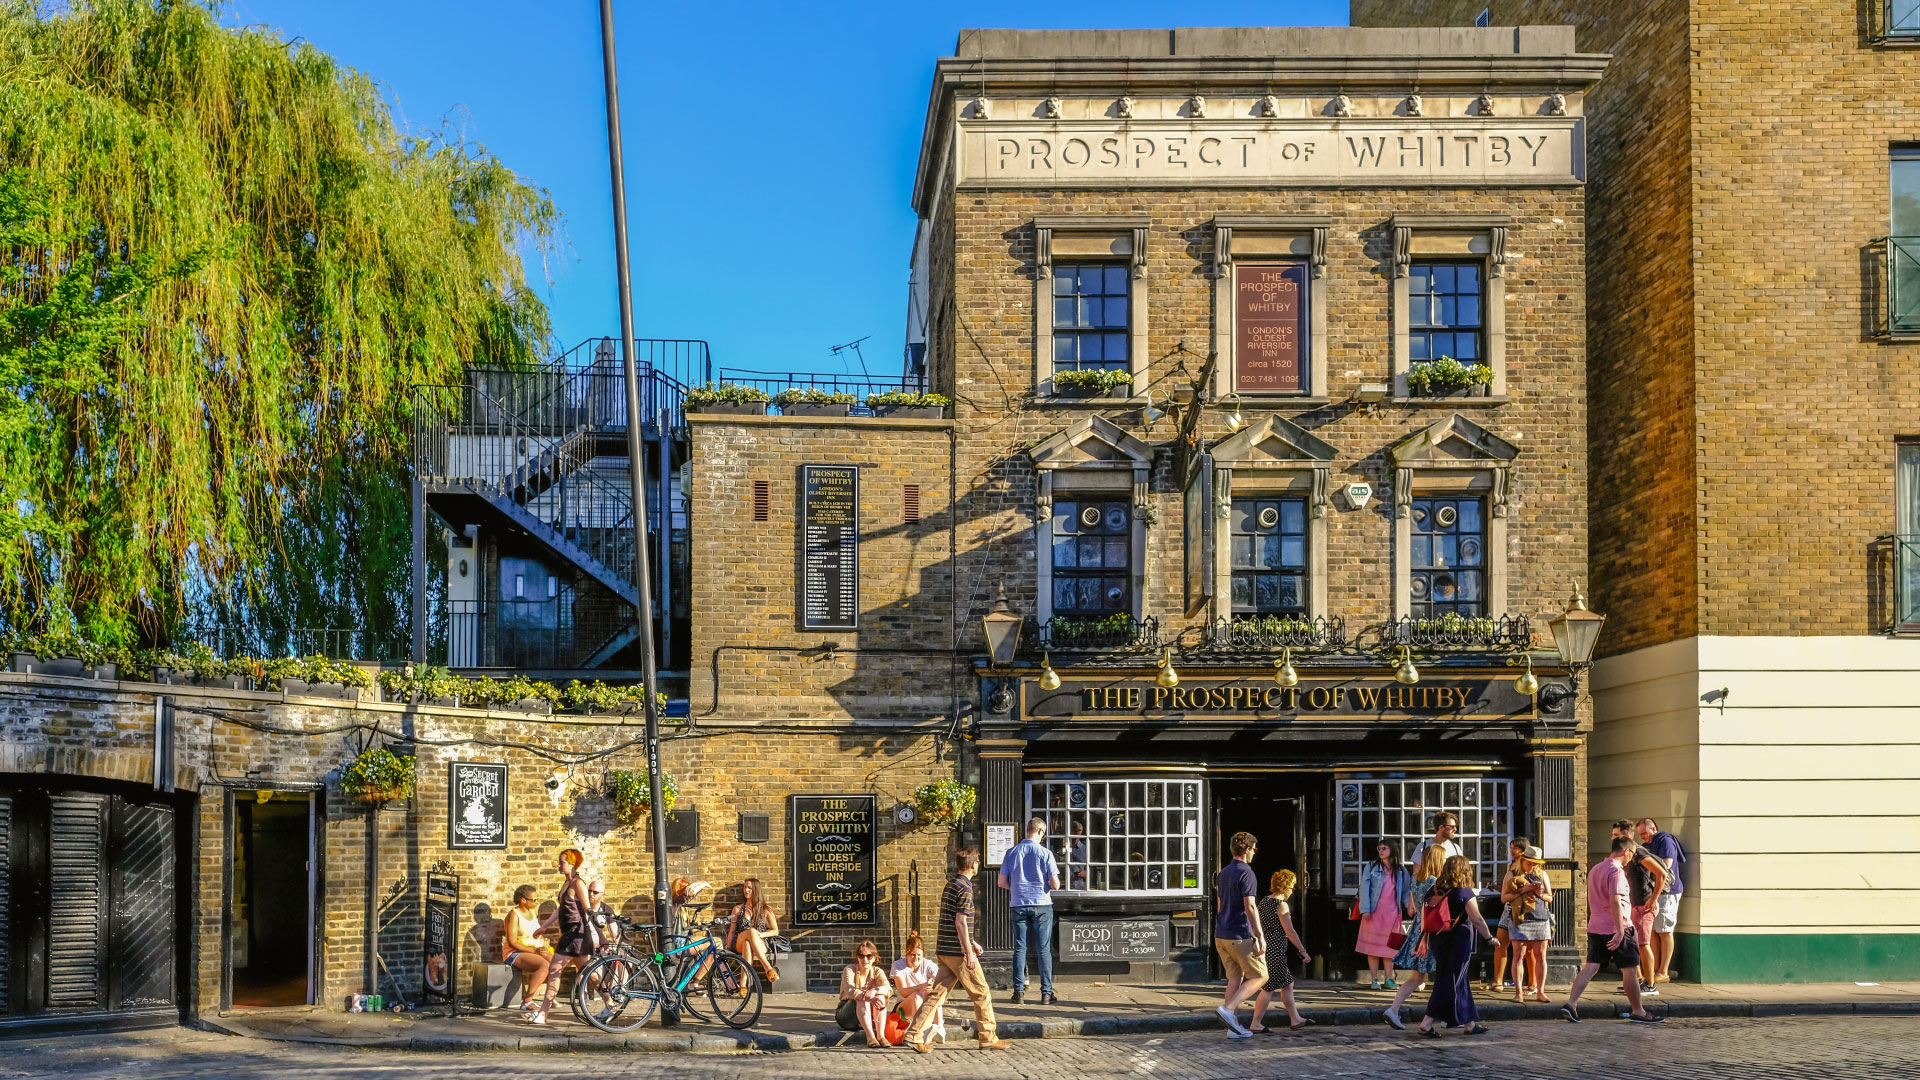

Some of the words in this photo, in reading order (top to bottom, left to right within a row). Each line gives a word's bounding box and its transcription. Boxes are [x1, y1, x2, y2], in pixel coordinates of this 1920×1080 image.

[997, 137, 1256, 170] PROSPECT
[1281, 142, 1316, 162] OF
[1345, 136, 1548, 168] WHITBY
[1260, 272, 1282, 282] THE
[1240, 282, 1299, 292] PROSPECT
[1262, 292, 1278, 302] OF
[1248, 302, 1291, 312] WHITBY
[1247, 326, 1292, 334] LONDON'S
[1253, 334, 1286, 342] OLDEST
[1247, 360, 1268, 368] circa
[1271, 360, 1292, 368] 1520
[1241, 375, 1256, 383] 020
[1258, 375, 1277, 383] 7481
[810, 470, 852, 478] PROSPECT
[821, 478, 853, 486] WHITBY
[1082, 687, 1142, 709] THE
[1153, 687, 1302, 710] PROSPECT
[1309, 687, 1347, 710] OF
[1356, 687, 1474, 710] WHITBY
[649, 738, 657, 775] W1909
[820, 799, 848, 810] THE
[801, 811, 868, 822] PROSPECT
[798, 823, 817, 834] OF
[818, 823, 871, 834] WHITBY
[808, 843, 861, 852] LONDON'S
[814, 853, 856, 862] OLDEST
[808, 863, 862, 872] RIVERSIDE
[826, 872, 844, 881] INN
[802, 891, 834, 902] Circa
[838, 892, 867, 902] 1520
[801, 912, 819, 921] 020
[821, 912, 843, 921] 7481
[847, 912, 869, 921] 1095
[1072, 928, 1111, 942] FOOD
[1069, 944, 1089, 952] ALL
[1093, 944, 1112, 952] DAY
